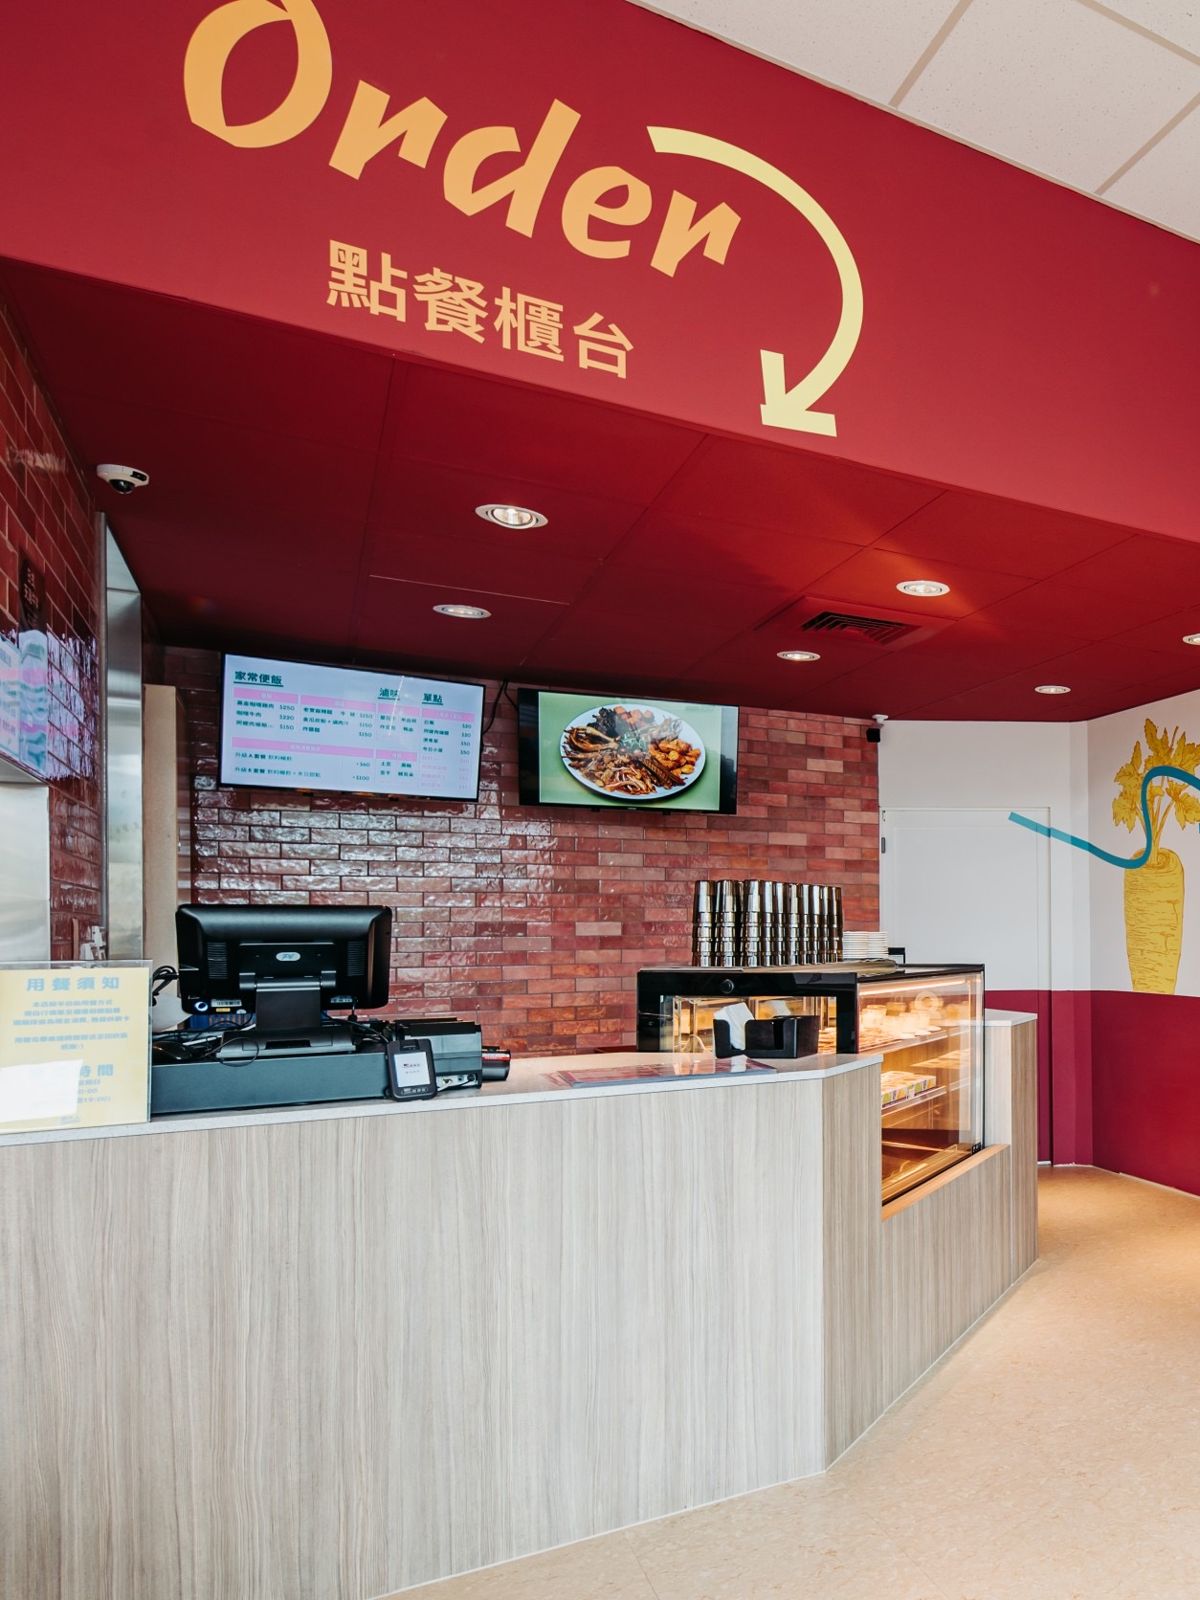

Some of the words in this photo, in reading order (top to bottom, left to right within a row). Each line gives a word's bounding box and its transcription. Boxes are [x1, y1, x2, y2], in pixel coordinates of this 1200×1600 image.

[184, 0, 741, 278] Order
[327, 239, 635, 379] 點餐櫃台
[233, 670, 283, 685] 家常便飯
[423, 692, 443, 703] 單點
[27, 976, 120, 992] 用餐須知
